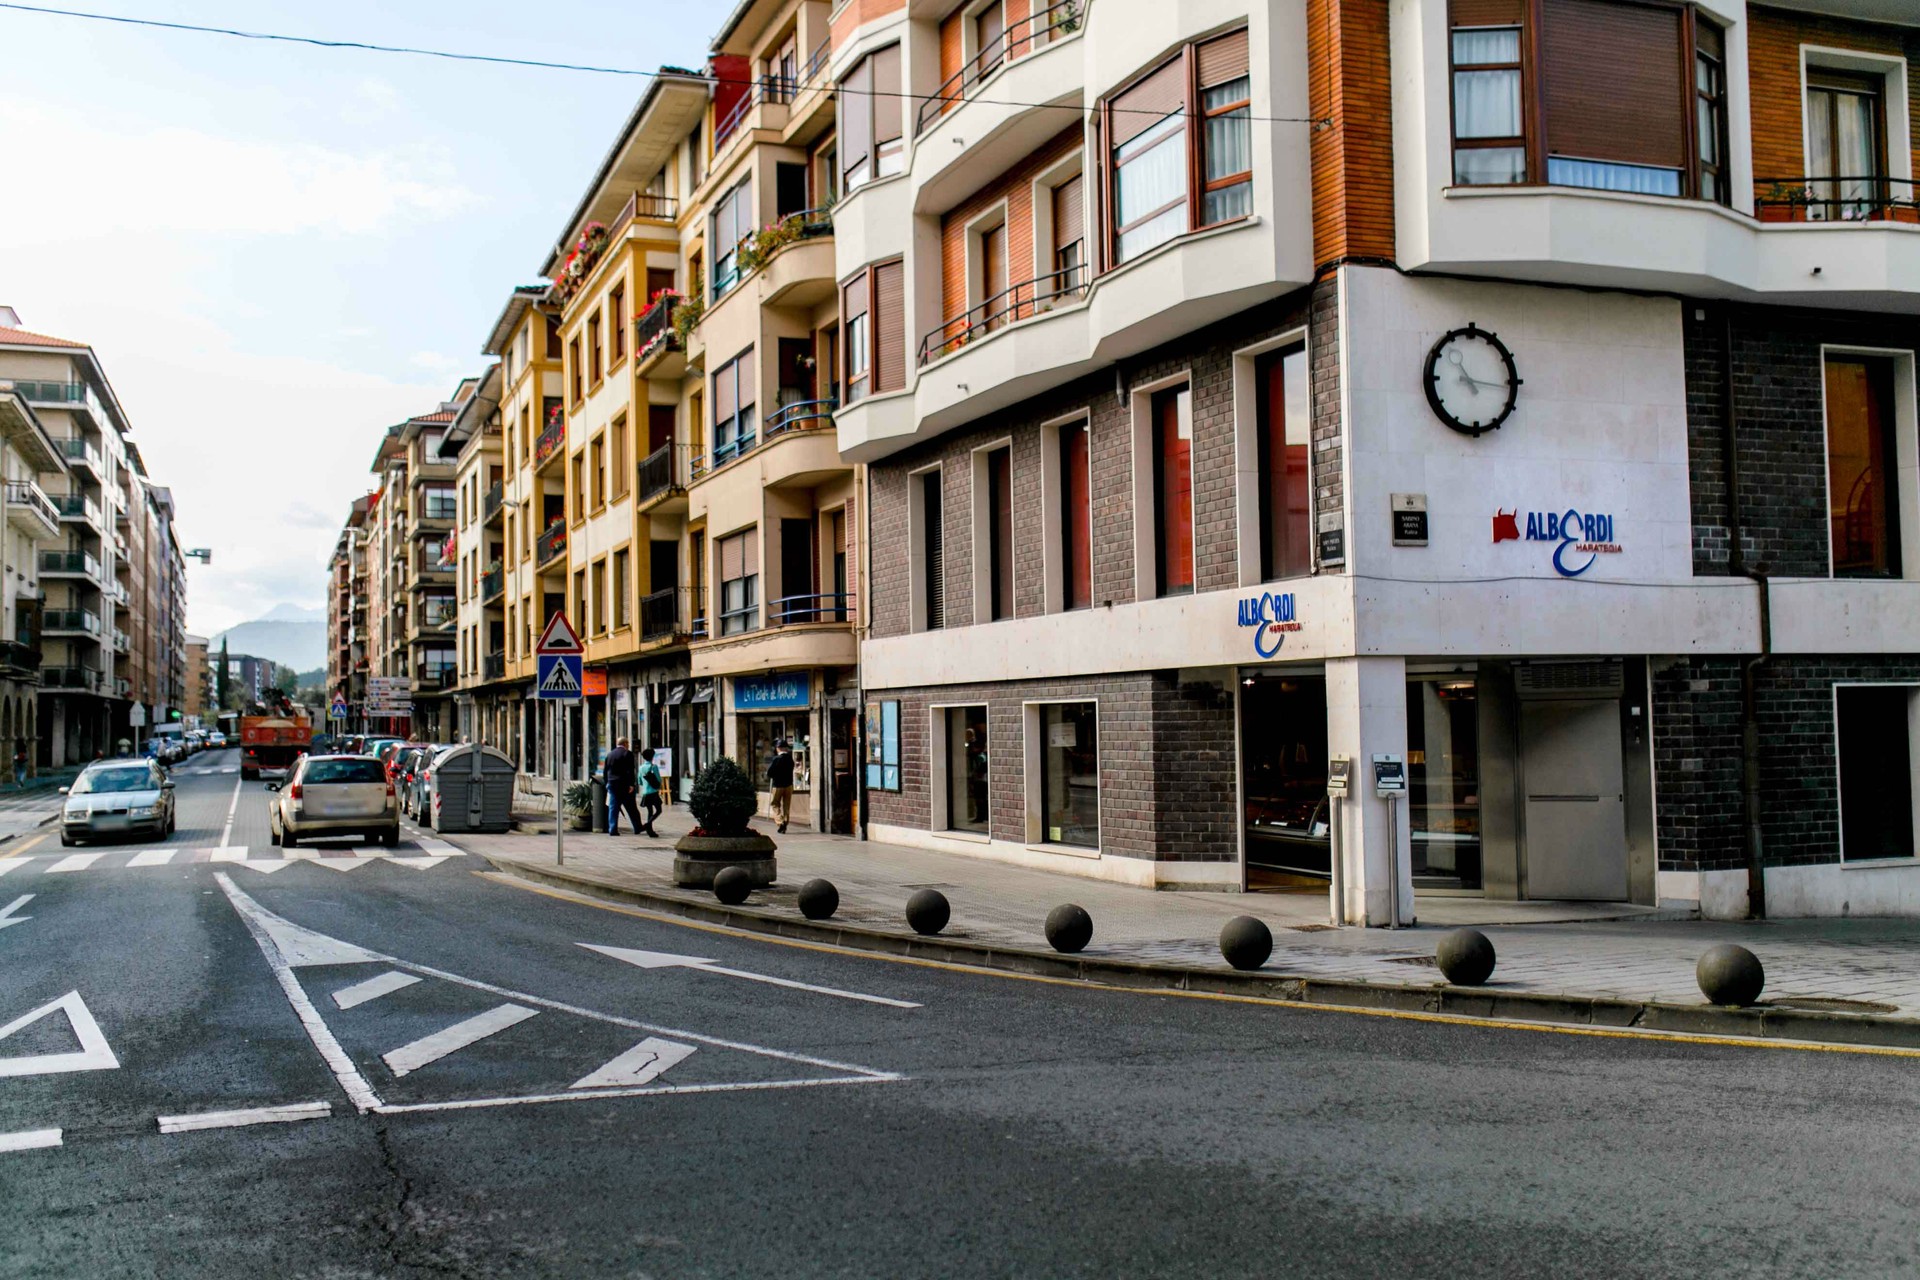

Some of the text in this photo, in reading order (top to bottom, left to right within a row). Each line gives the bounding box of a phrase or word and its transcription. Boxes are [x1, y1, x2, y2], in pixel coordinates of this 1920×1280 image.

[1526, 508, 1613, 577] ALBERDI
[1575, 543, 1623, 553] HARATEGIA
[1238, 592, 1296, 659] ALBERDI
